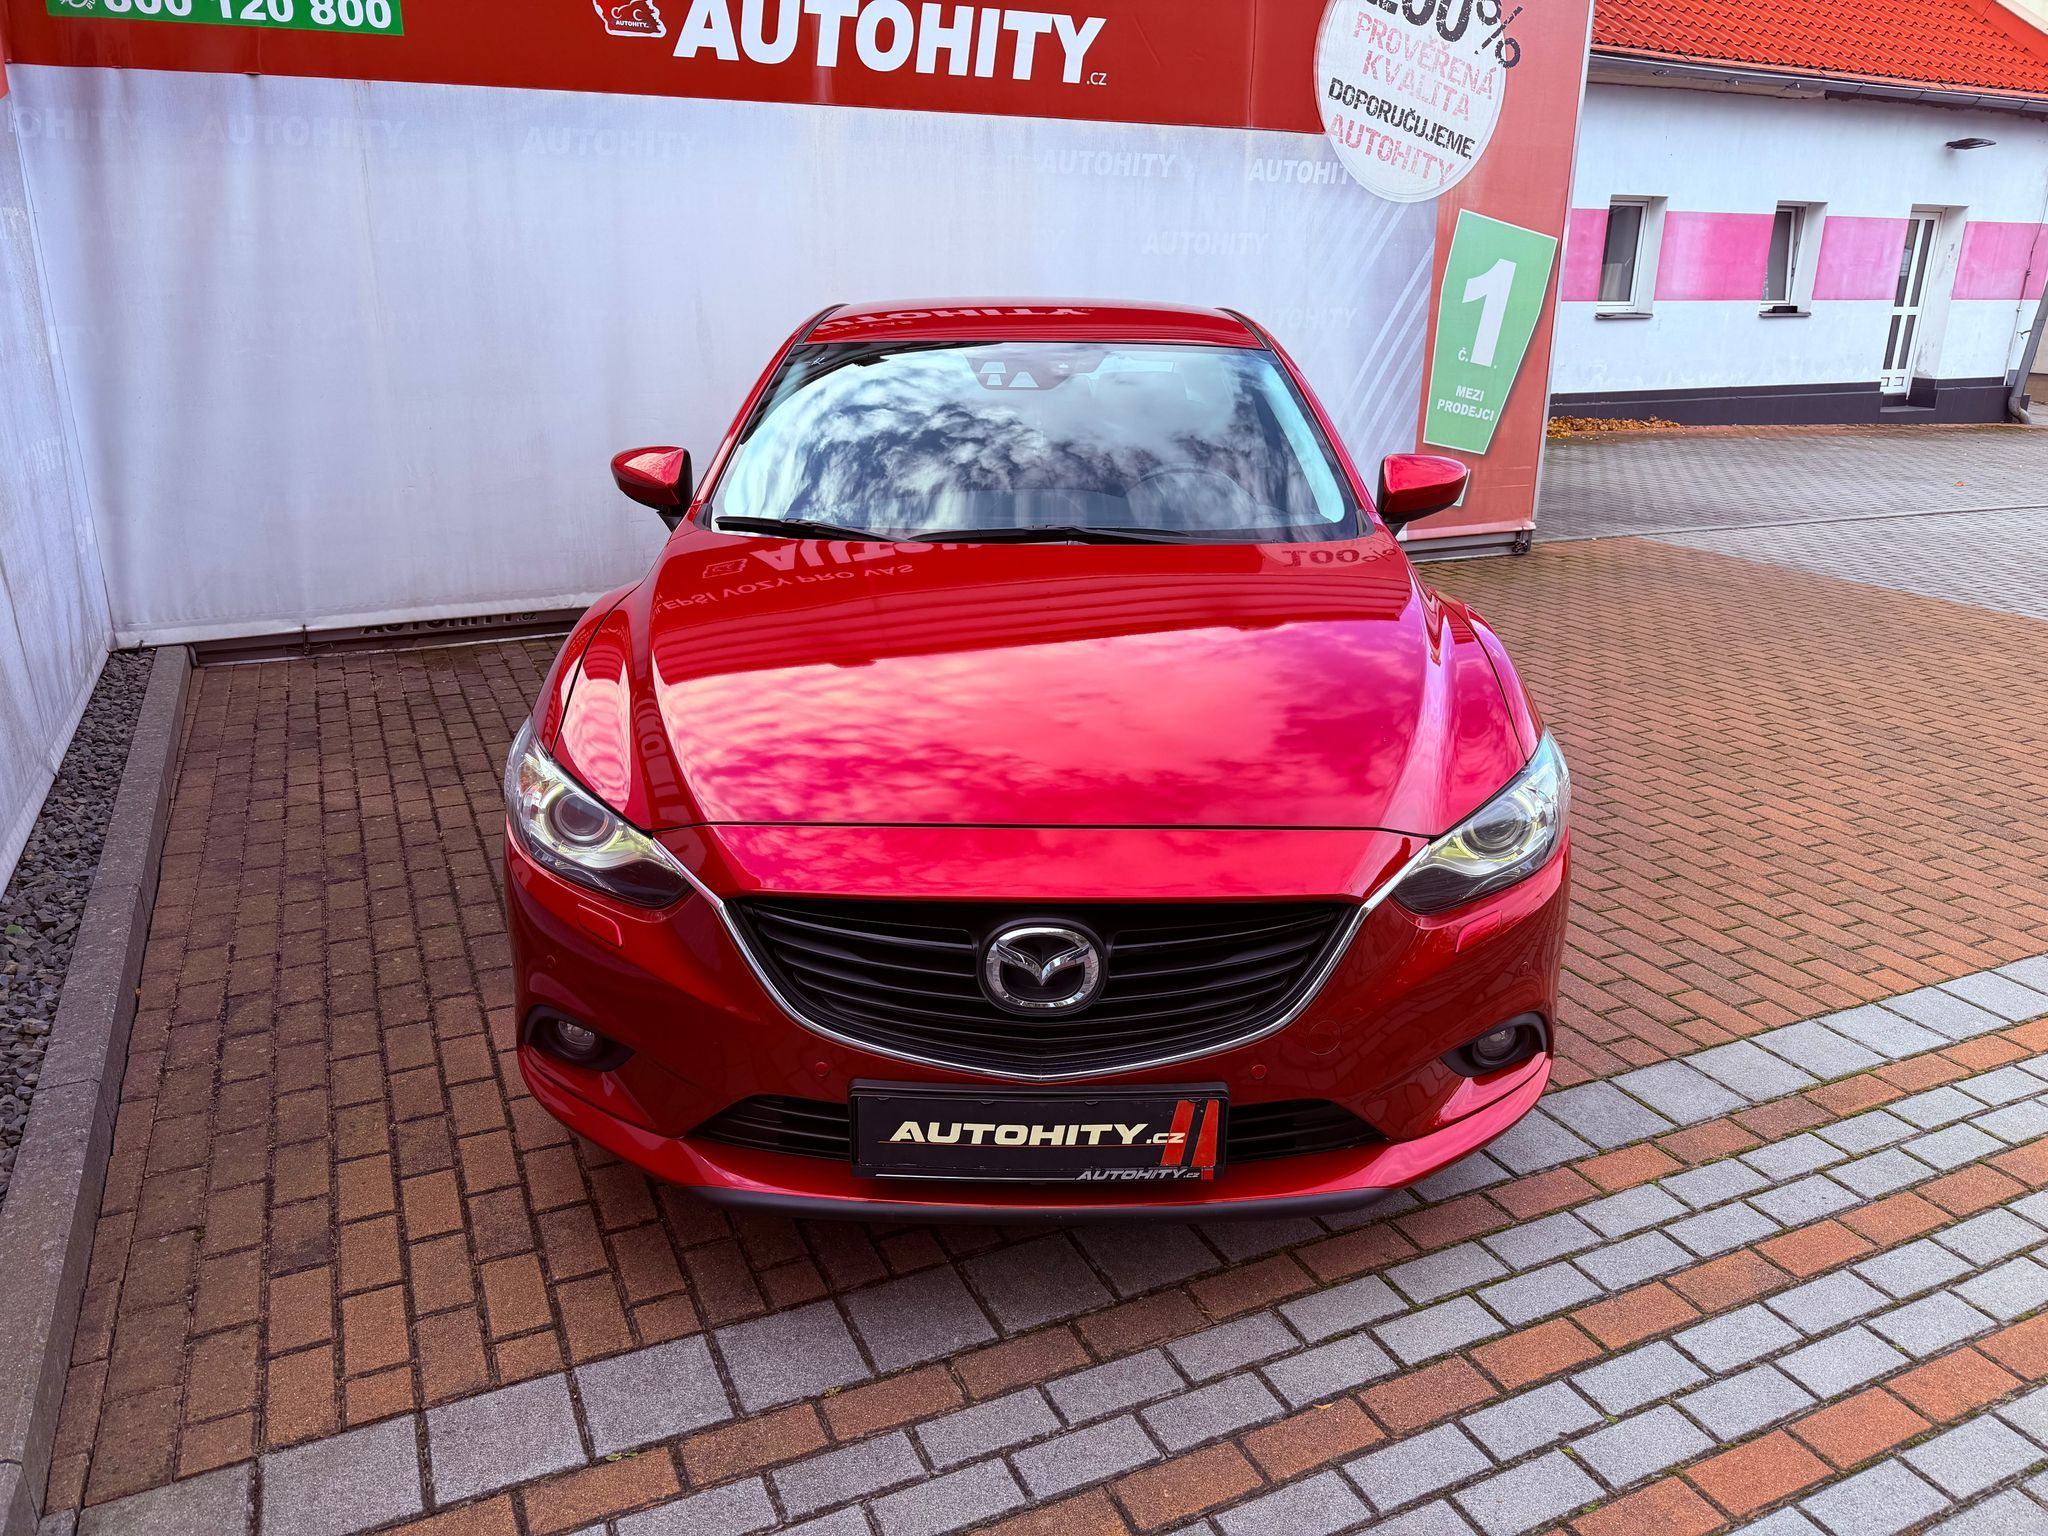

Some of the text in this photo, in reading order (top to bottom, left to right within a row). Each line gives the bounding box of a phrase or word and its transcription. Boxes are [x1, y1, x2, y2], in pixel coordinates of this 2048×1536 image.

[310, 0, 392, 29] 800
[1353, 11, 1497, 100] PROVĚŘENÁ
[1362, 50, 1470, 121] KVALITA
[1328, 77, 1475, 160] DOPORUČUJEME
[1041, 149, 1176, 178] AUTOHITY
[1329, 113, 1455, 187] AUTOHITY
[1249, 159, 1358, 185] AUTOHIT
[1456, 385, 1485, 402] MEZI
[1437, 399, 1495, 421] PRODEJCI
[889, 1121, 1186, 1145] AUTOHITY.cz
